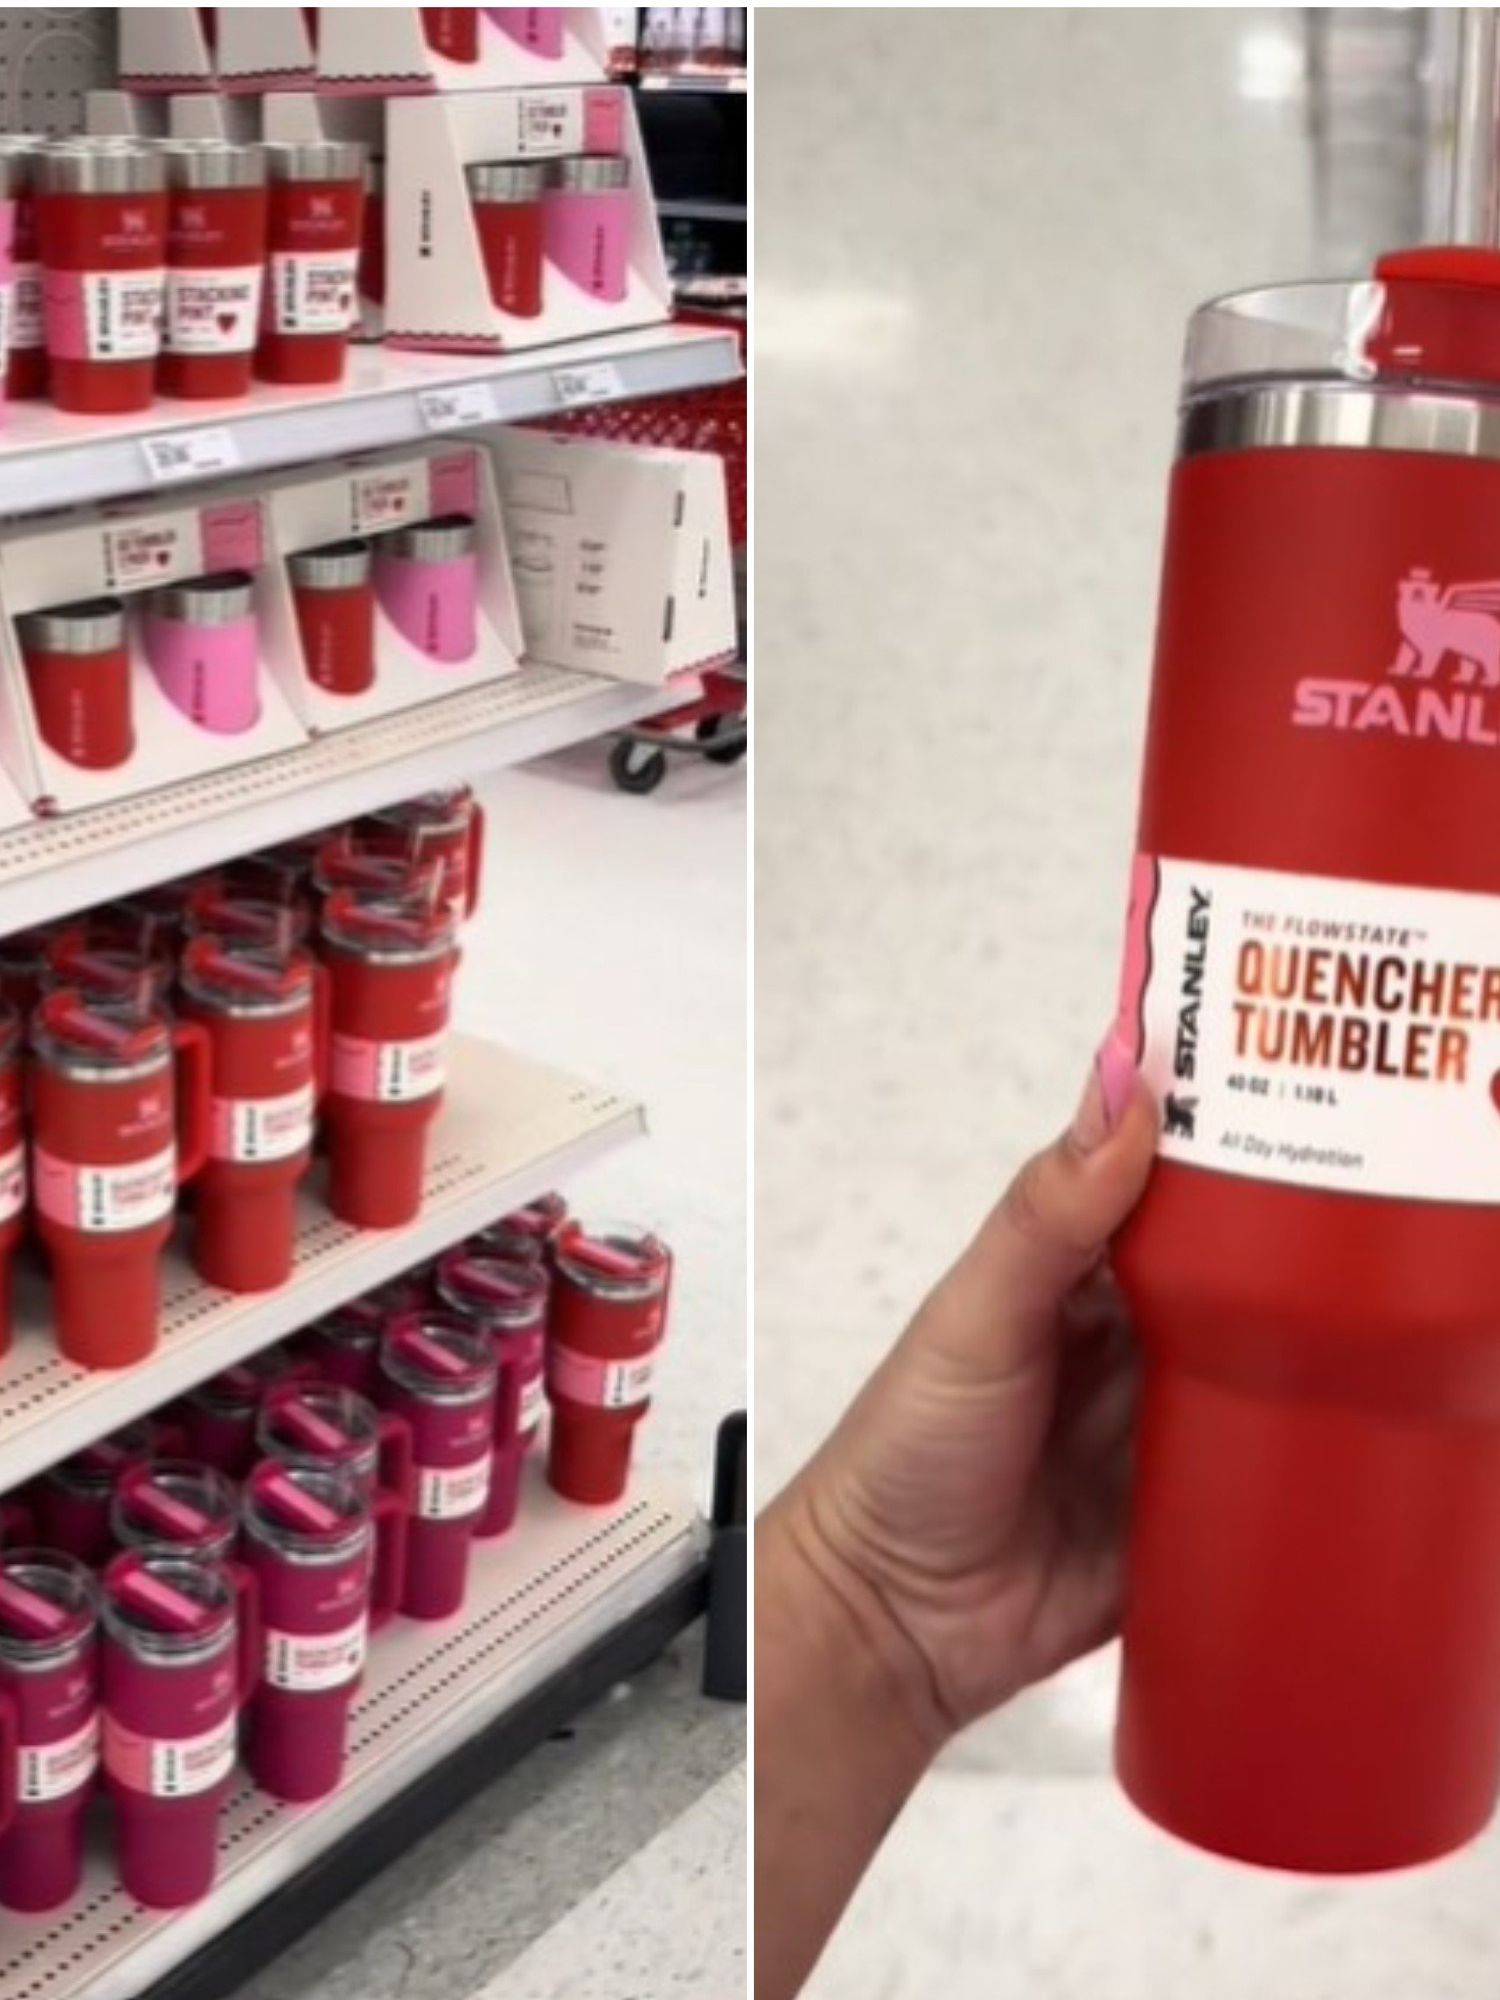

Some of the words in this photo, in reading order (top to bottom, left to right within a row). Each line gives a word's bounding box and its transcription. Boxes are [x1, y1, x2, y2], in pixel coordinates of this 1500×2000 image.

[1292, 677, 1500, 746] STANL
[1241, 910, 1275, 933] THE
[1173, 885, 1212, 1082] STANLEY
[1236, 938, 1500, 1023] QUENCHER
[1232, 1000, 1470, 1084] TUMBLER
[1242, 1132, 1274, 1161] Day
[1277, 1141, 1364, 1169] Hydration
